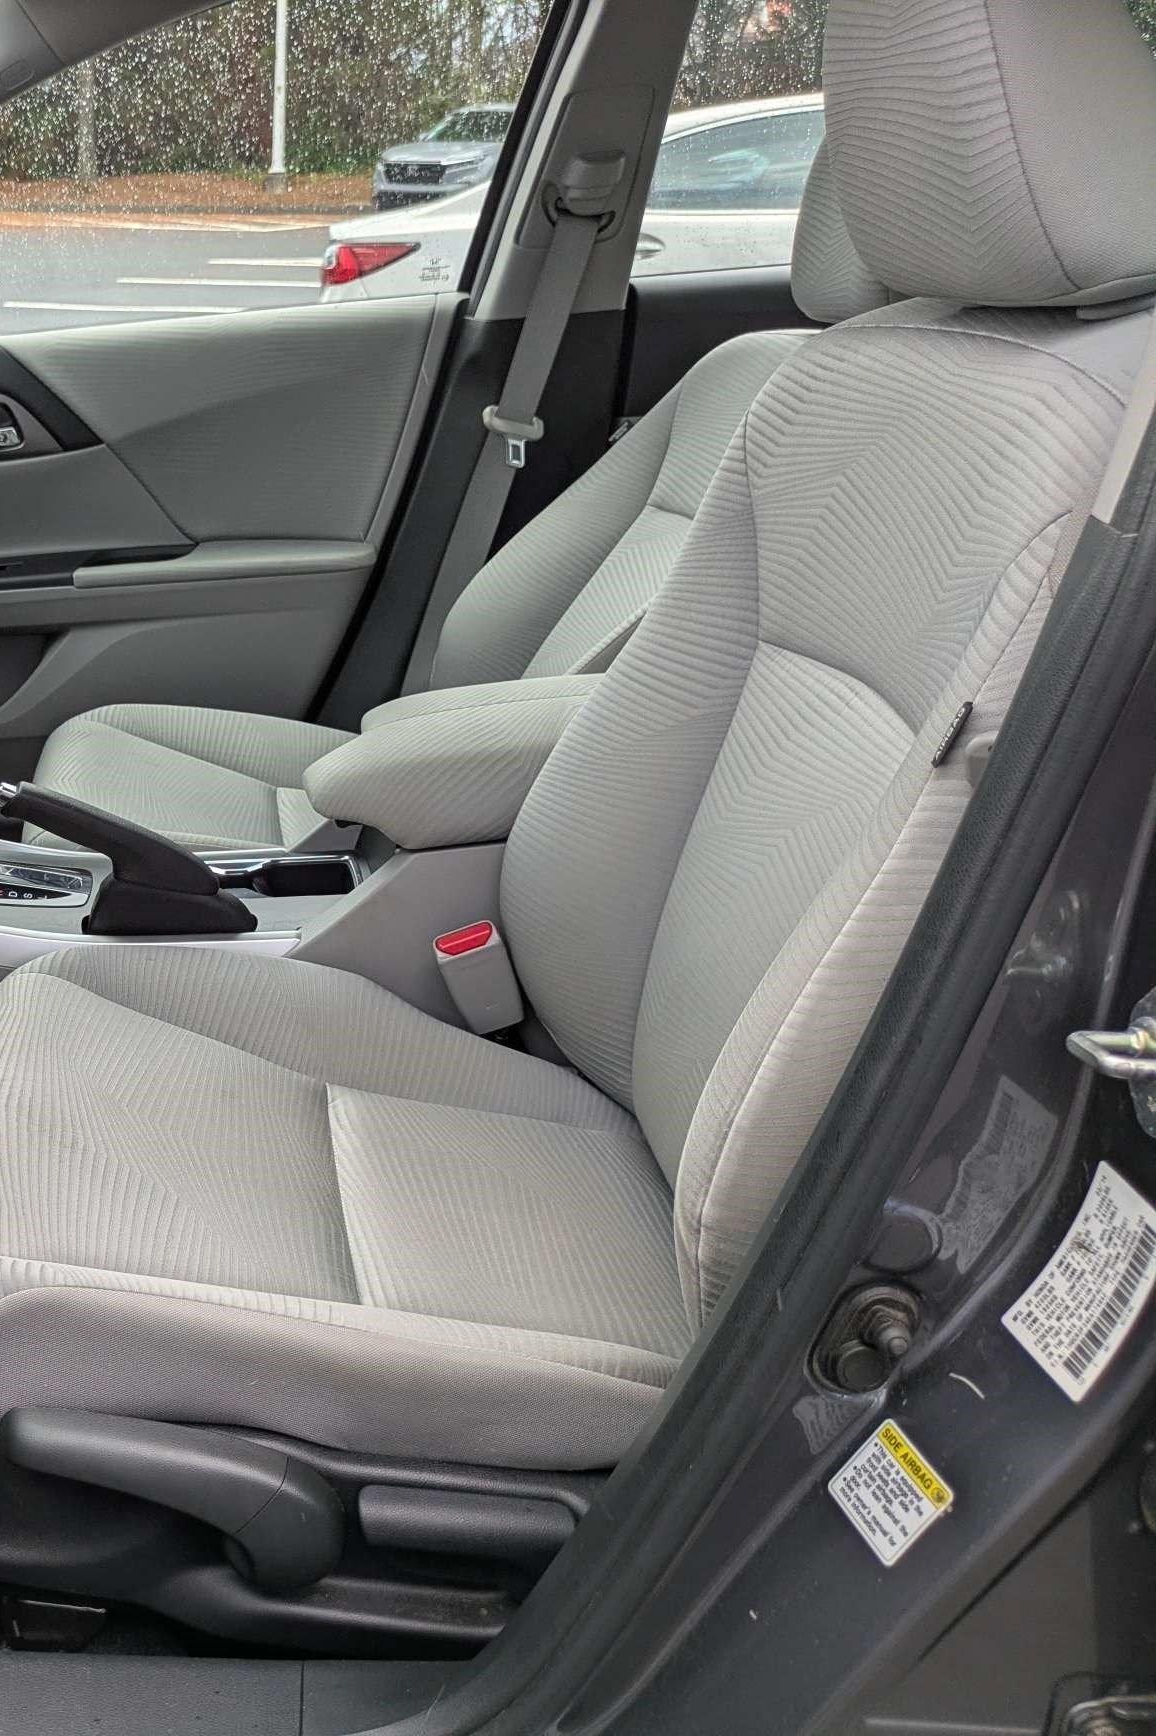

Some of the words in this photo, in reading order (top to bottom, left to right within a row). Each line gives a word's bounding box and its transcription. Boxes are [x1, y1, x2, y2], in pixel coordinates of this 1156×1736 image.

[1032, 1279, 1049, 1298] HONDA
[1043, 1296, 1065, 1321] VEHICLE
[1064, 1286, 1093, 1322] PREVENTION
[1033, 1323, 1054, 1347] FEDERAL
[848, 1474, 862, 1490] door.
[870, 1451, 882, 1465] with
[879, 1463, 892, 1477] side
[889, 1476, 909, 1499] airbags
[907, 1497, 915, 1506] in
[913, 1504, 924, 1517] the
[875, 1445, 888, 1460] This
[885, 1458, 895, 1469] car
[893, 1468, 901, 1476] is
[898, 1474, 923, 1503] equipped
[882, 1428, 903, 1450] SIDE
[900, 1452, 933, 1490] AIRBAG
[854, 1468, 863, 1479] Do
[861, 1478, 872, 1489] not
[870, 1488, 882, 1503] lean
[880, 1503, 901, 1526] against
[898, 1524, 909, 1537] the
[859, 1463, 877, 1484] curtain
[874, 1483, 895, 1507] airbags.
[865, 1456, 878, 1472] front
[875, 1471, 890, 1488] seats
[887, 1486, 900, 1500] and
[897, 1498, 910, 1513] side
[838, 1486, 852, 1502] more
[849, 1501, 880, 1536] information.
[843, 1480, 855, 1493] See
[852, 1492, 872, 1515] owner's
[870, 1514, 890, 1537] manual
[886, 1535, 897, 1547] for
